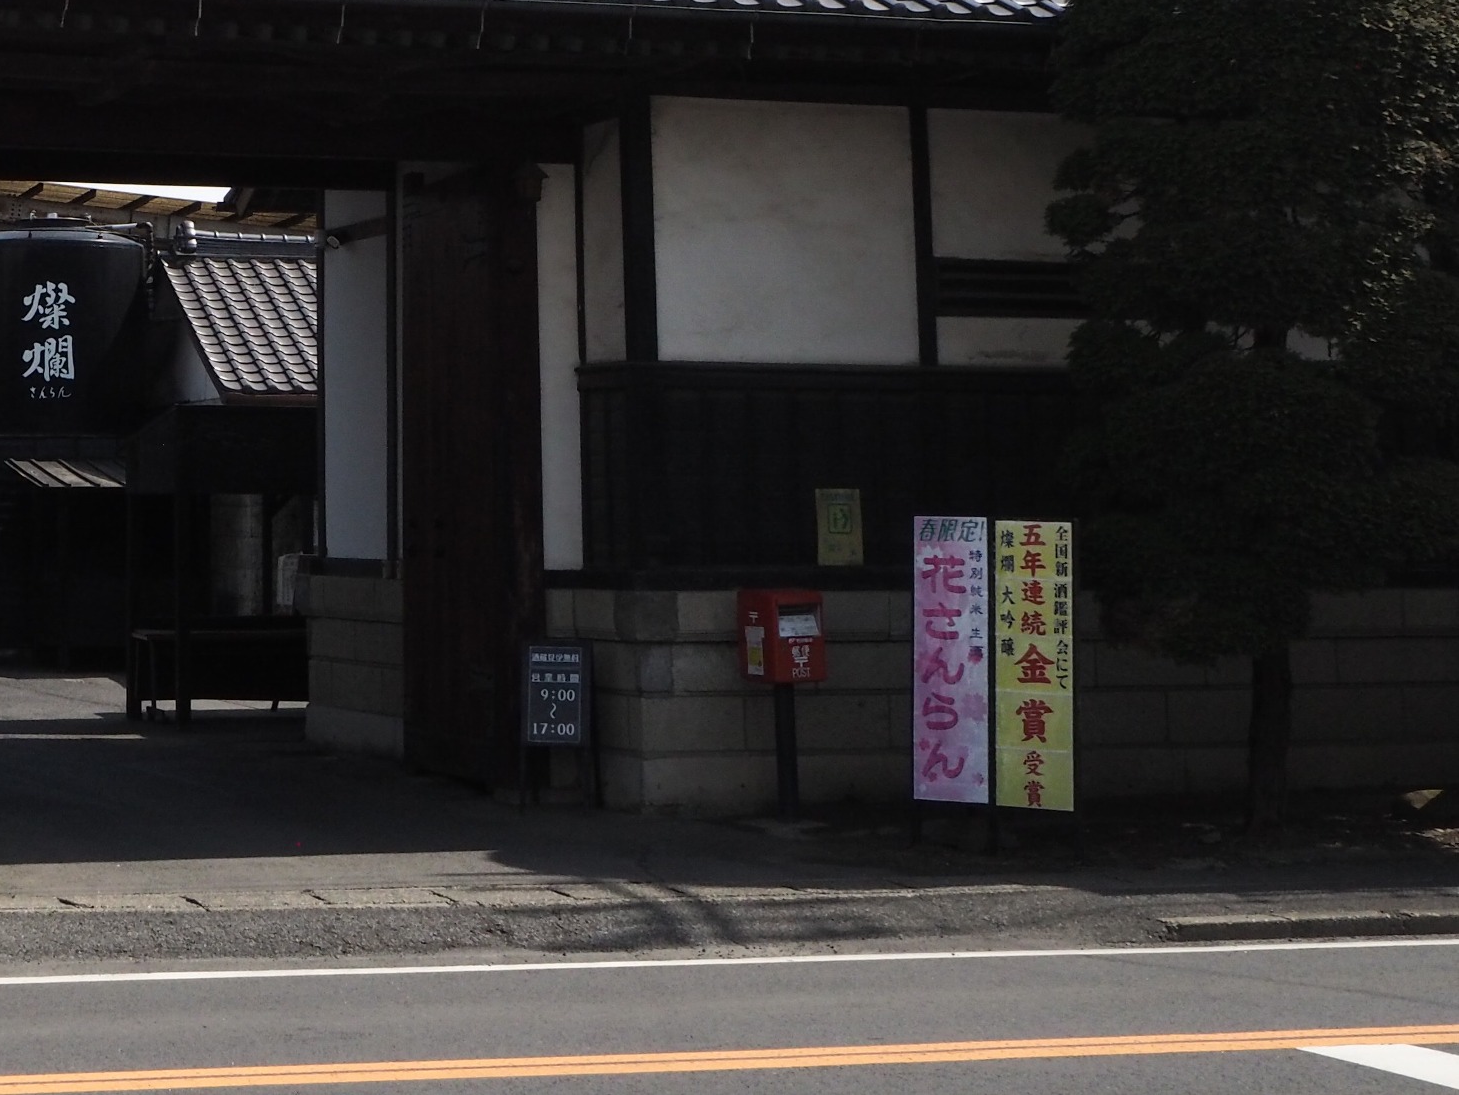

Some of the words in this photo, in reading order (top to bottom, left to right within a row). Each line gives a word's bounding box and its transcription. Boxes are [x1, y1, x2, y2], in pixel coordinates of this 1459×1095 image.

[21, 280, 76, 382] 燦爛
[29, 386, 72, 399] さんらん
[791, 667, 812, 678] POST
[921, 554, 968, 782] 花さんらん
[540, 689, 576, 702] 9:00
[532, 722, 576, 736] 17:00
